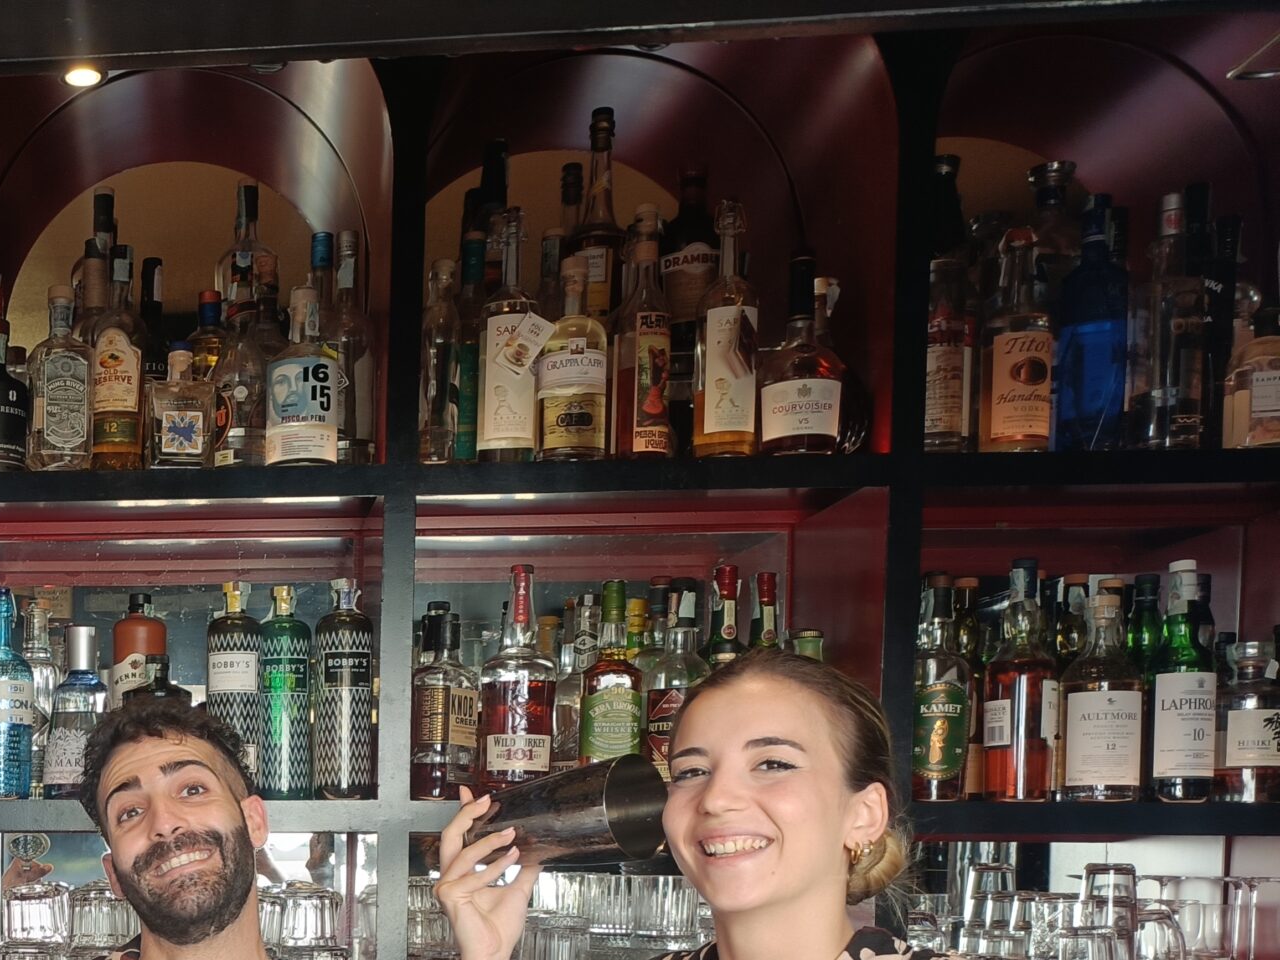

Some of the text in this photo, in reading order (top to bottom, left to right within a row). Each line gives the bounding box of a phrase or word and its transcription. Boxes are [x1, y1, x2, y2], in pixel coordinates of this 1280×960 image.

[664, 252, 719, 270] DRAMBU
[546, 358, 580, 372] GRAPPA
[103, 368, 118, 377] OLD
[303, 363, 330, 383] 16
[94, 374, 133, 386] RESERVE
[310, 385, 331, 412] 15
[996, 388, 1050, 405] Handma
[771, 402, 833, 415] COURVOISIER
[212, 659, 251, 670] BOBBY'S
[265, 663, 305, 673] BOBBY'S
[328, 657, 368, 667] BOBBY'S
[451, 693, 474, 718] KNOB
[919, 703, 963, 714] KAMET
[1161, 697, 1215, 712] LAPHRO
[455, 716, 477, 727] CREEK
[1080, 711, 1138, 722] AULTMORE
[594, 726, 639, 734] WHISKEY
[648, 721, 674, 733] RITTEN
[1192, 727, 1205, 741] 10
[493, 735, 546, 748] WILD URKEY
